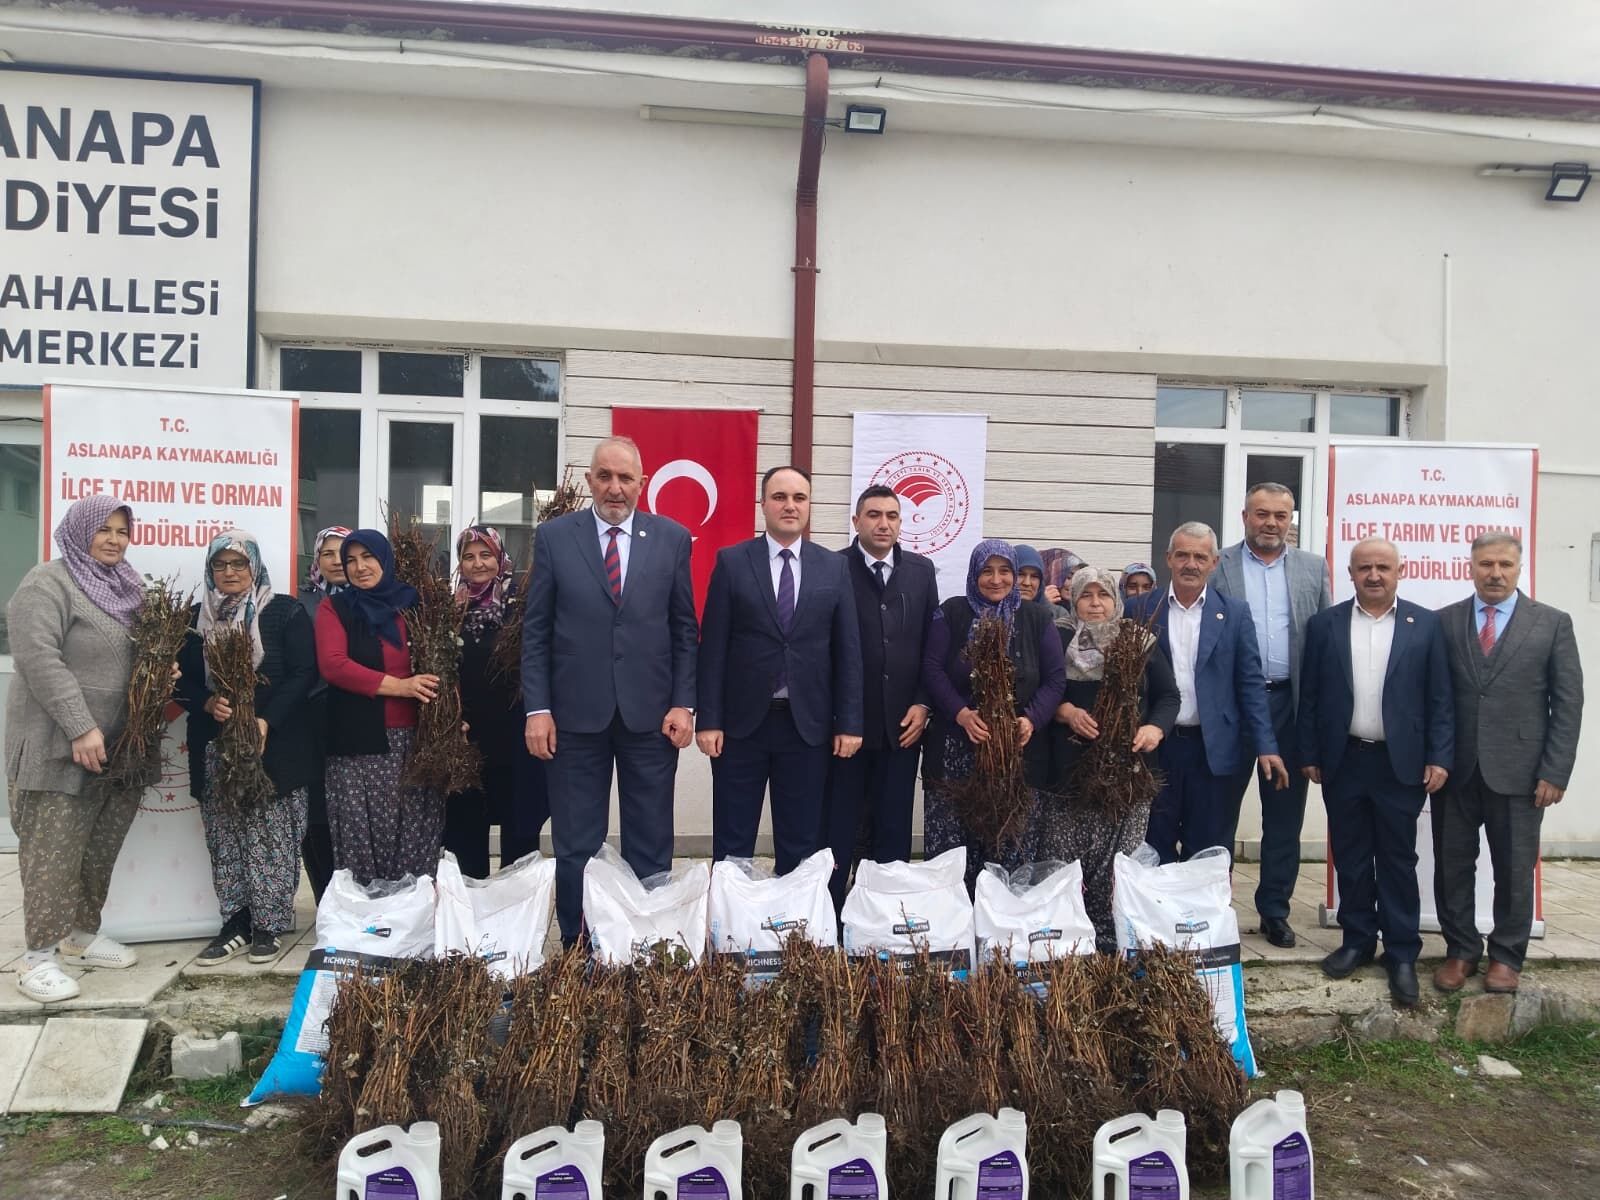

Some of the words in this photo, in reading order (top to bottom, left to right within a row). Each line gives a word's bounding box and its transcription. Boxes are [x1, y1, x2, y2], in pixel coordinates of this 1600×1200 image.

[160, 417, 190, 433] T.C.
[67, 442, 152, 460] ASLANAPA
[157, 447, 278, 466] KAYMAKAMLIĞI
[1421, 469, 1446, 482] T.C.
[110, 479, 175, 503] TARIM
[181, 482, 206, 505] VE
[212, 483, 282, 507] ORMAN
[1346, 493, 1415, 505] ASLANAPA
[1419, 493, 1519, 508] KAYMAKAMLIĞI
[1383, 522, 1434, 542] TARIM
[1440, 524, 1460, 543] VE
